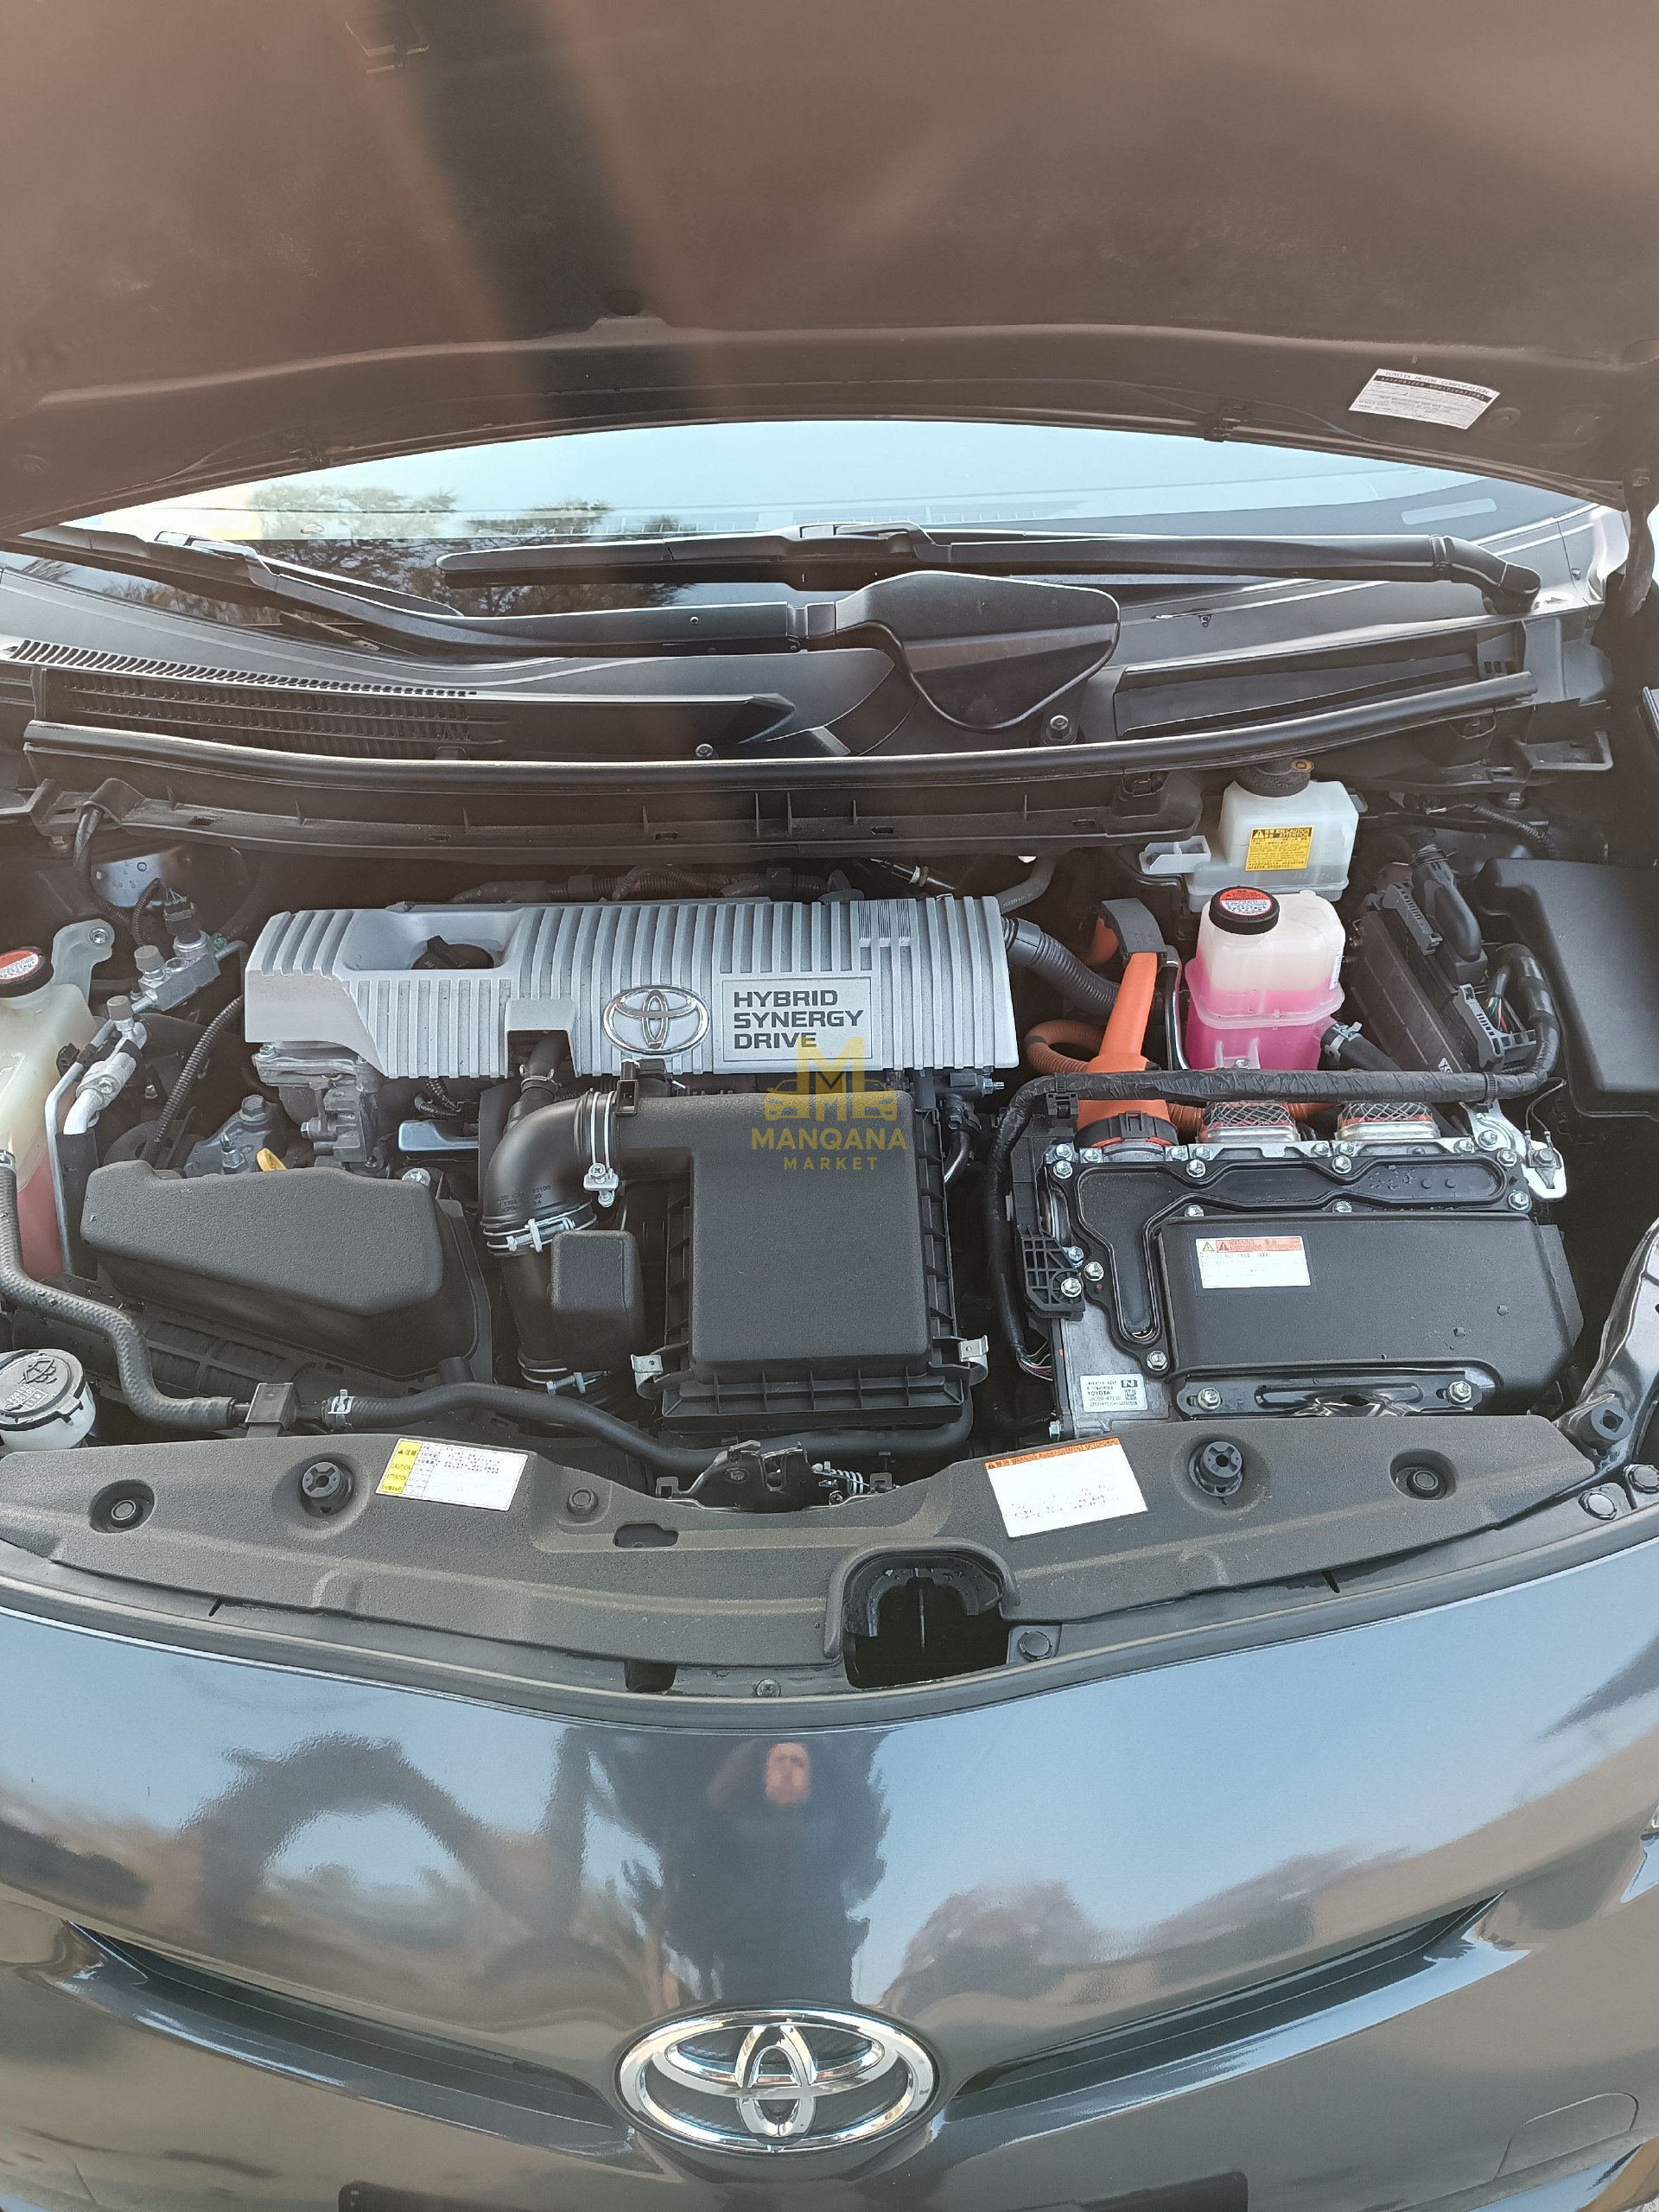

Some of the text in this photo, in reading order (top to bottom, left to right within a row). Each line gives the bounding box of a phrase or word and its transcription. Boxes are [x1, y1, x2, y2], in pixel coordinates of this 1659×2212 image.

[1385, 371, 1411, 379] TOYOTA
[734, 989, 838, 1007] HYBRID
[734, 1010, 864, 1028] SYNERGY
[734, 1032, 817, 1049] DRIVE
